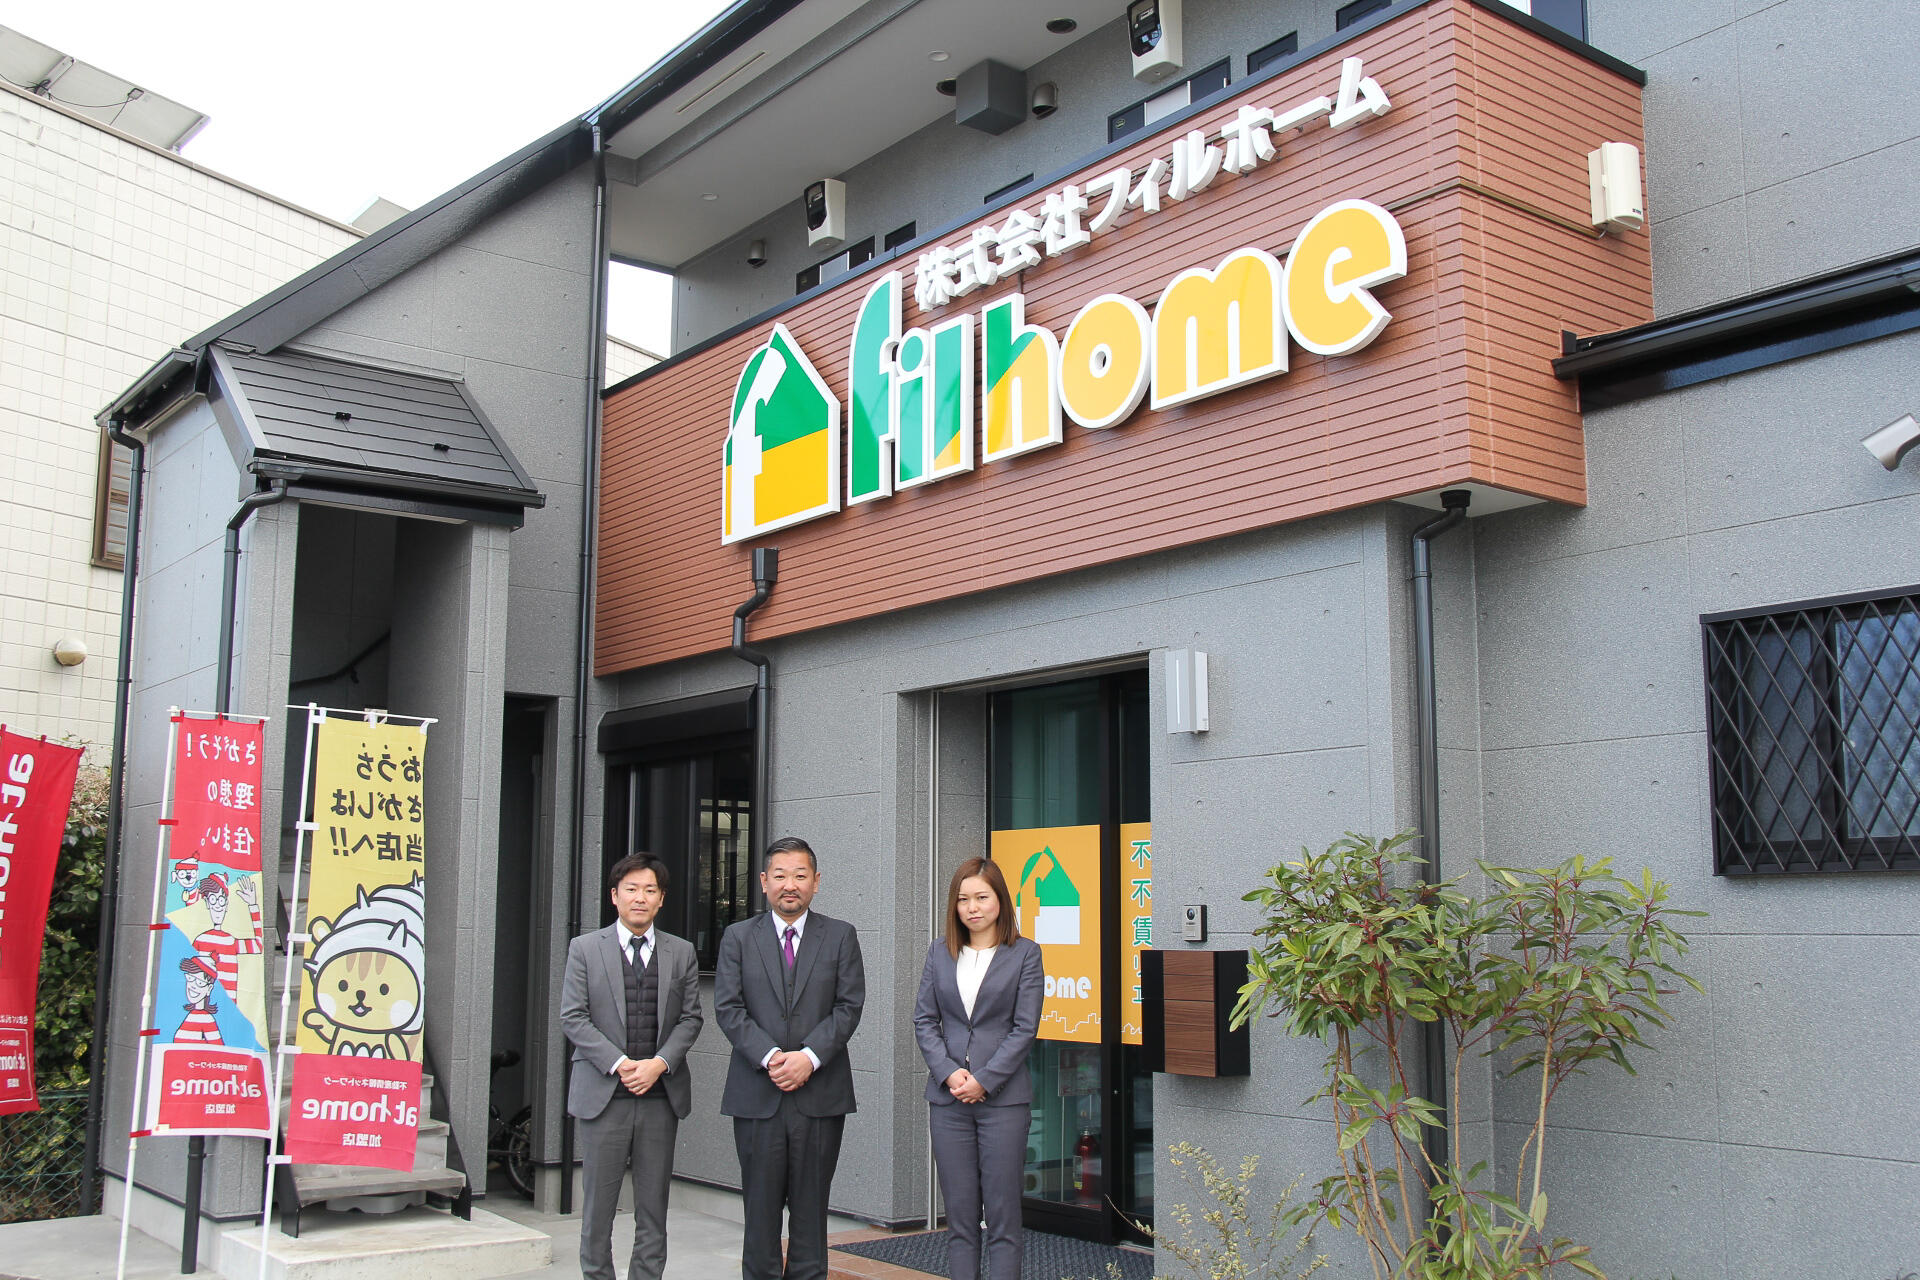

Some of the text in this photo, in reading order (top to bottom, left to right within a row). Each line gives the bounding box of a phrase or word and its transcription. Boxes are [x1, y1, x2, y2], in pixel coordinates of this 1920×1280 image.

[914, 57, 1392, 312] 株式会社フィルホーム
[1044, 975, 1092, 999] ome
